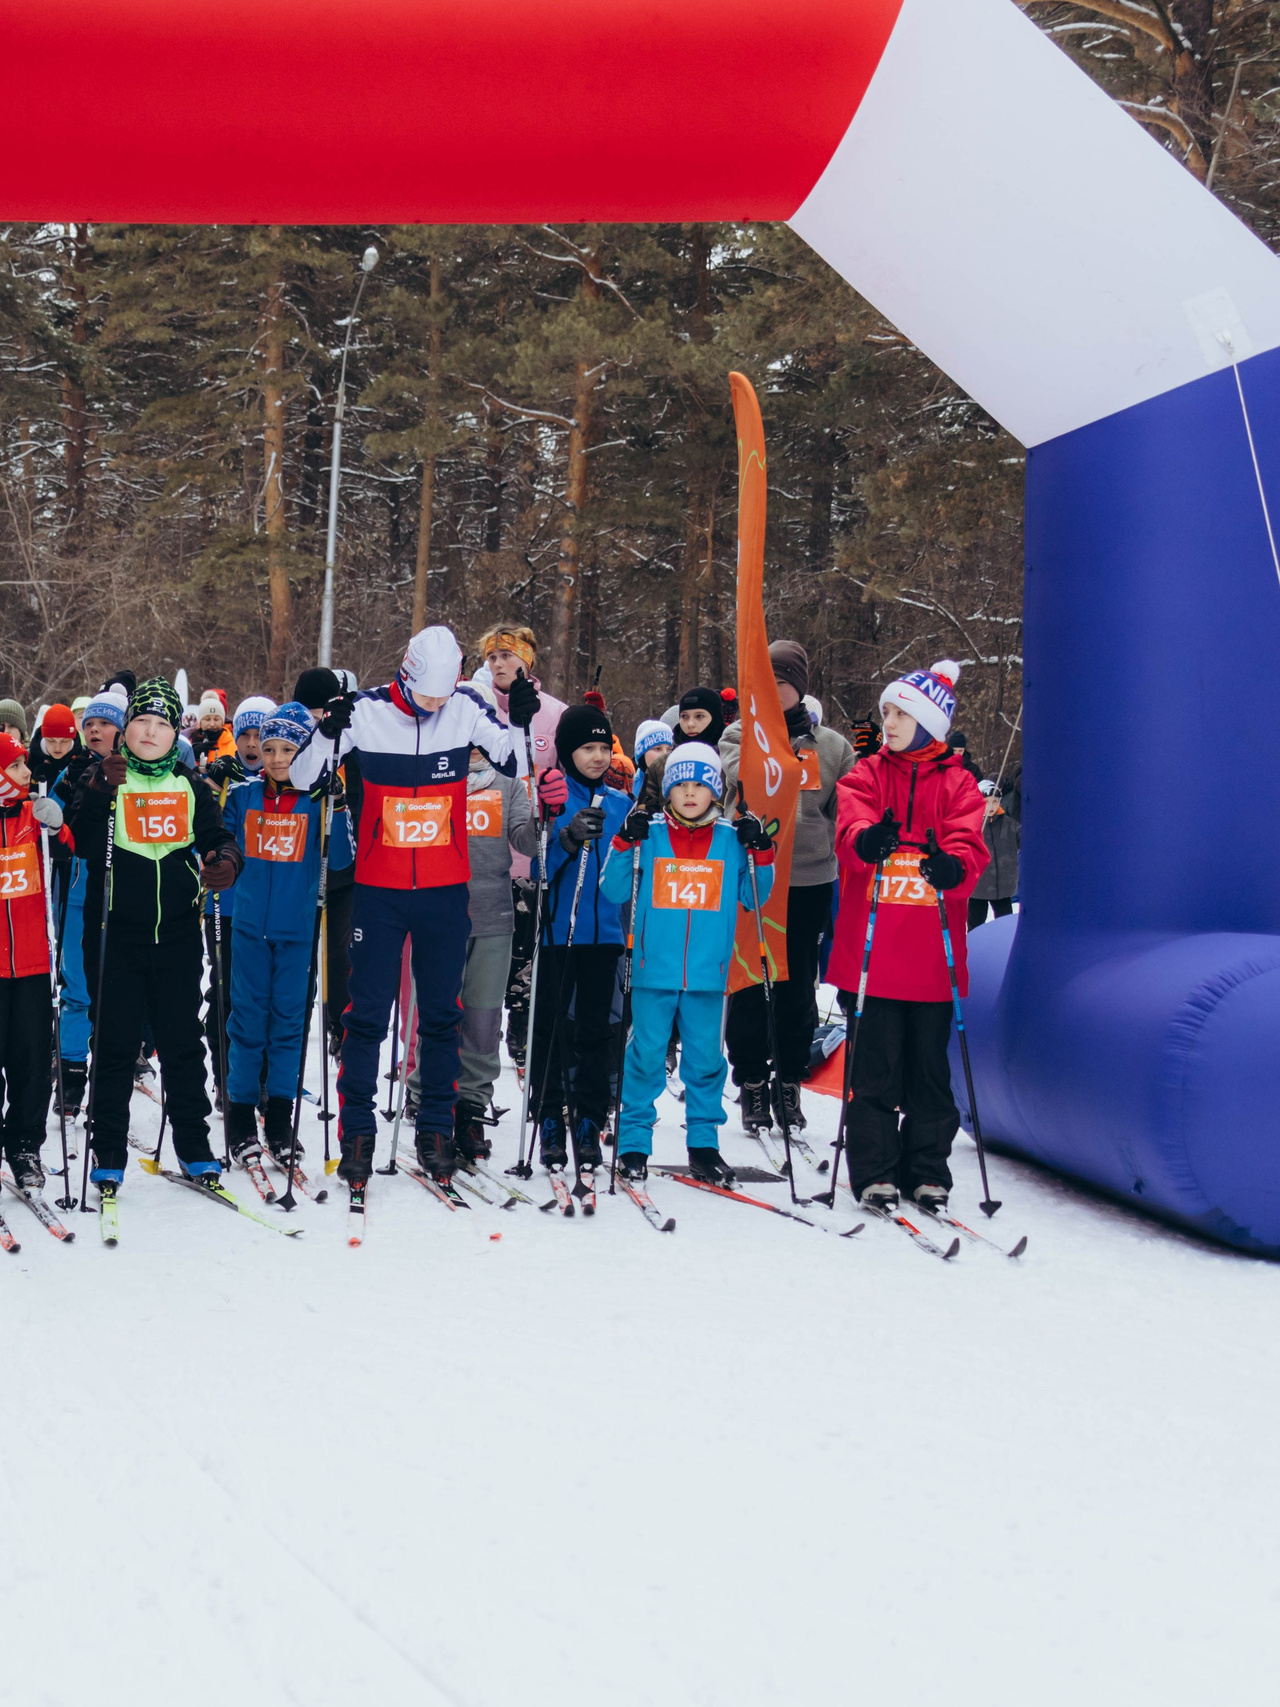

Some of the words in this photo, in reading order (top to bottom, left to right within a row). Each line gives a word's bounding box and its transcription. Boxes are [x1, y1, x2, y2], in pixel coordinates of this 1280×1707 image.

[919, 677, 956, 720] NIK
[85, 706, 117, 718] ОССИИ
[148, 798, 177, 806] Goodline
[408, 802, 441, 811] Goodline
[137, 816, 177, 838] 156
[266, 818, 297, 827] Goodline
[395, 821, 438, 842] 129
[105, 815, 115, 868] NORDWAY
[256, 833, 294, 857] 143
[679, 865, 713, 873] Goodline
[668, 882, 706, 904] 141
[881, 876, 925, 899] 173
